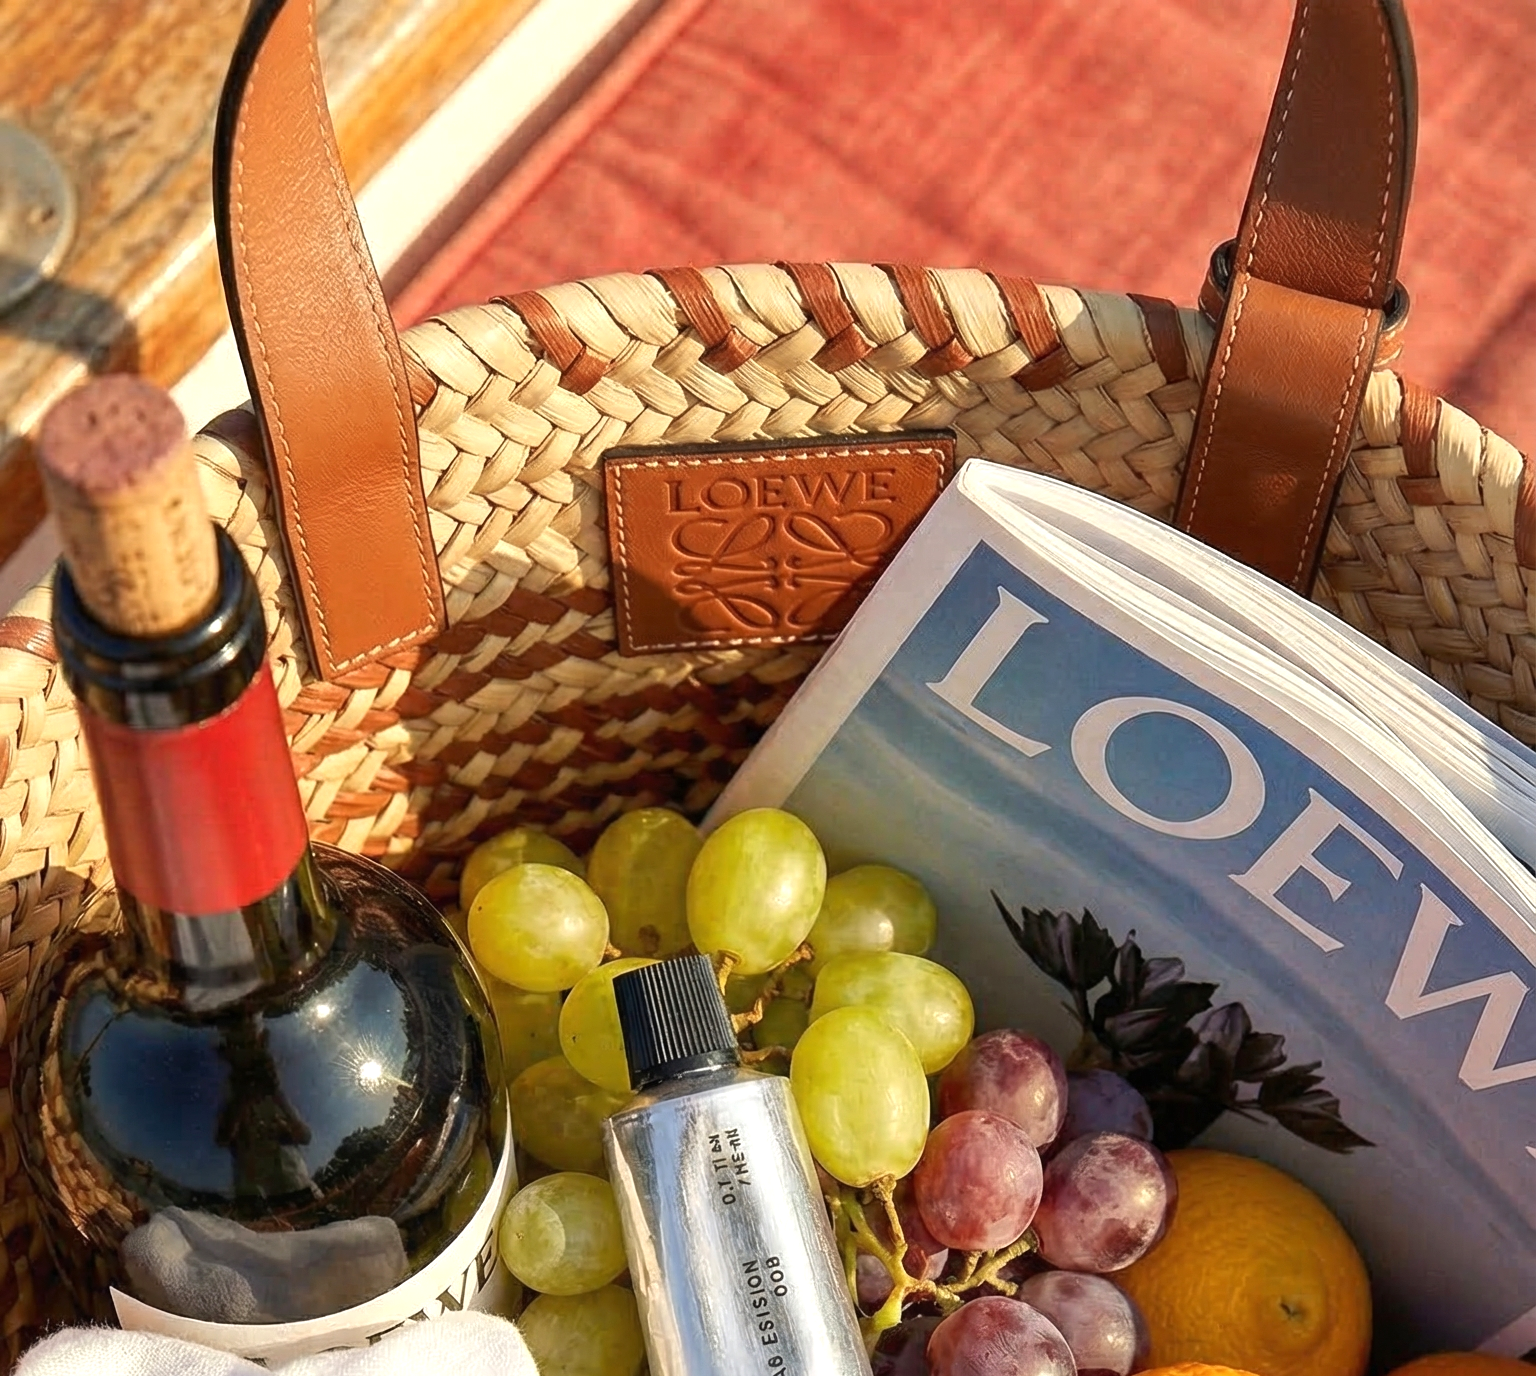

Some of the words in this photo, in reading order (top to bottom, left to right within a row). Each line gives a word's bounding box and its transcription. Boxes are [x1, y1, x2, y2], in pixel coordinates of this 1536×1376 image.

[664, 468, 897, 514] LOEWE
[925, 585, 1536, 1158] LOEW
[742, 1259, 779, 1346] ESISION
